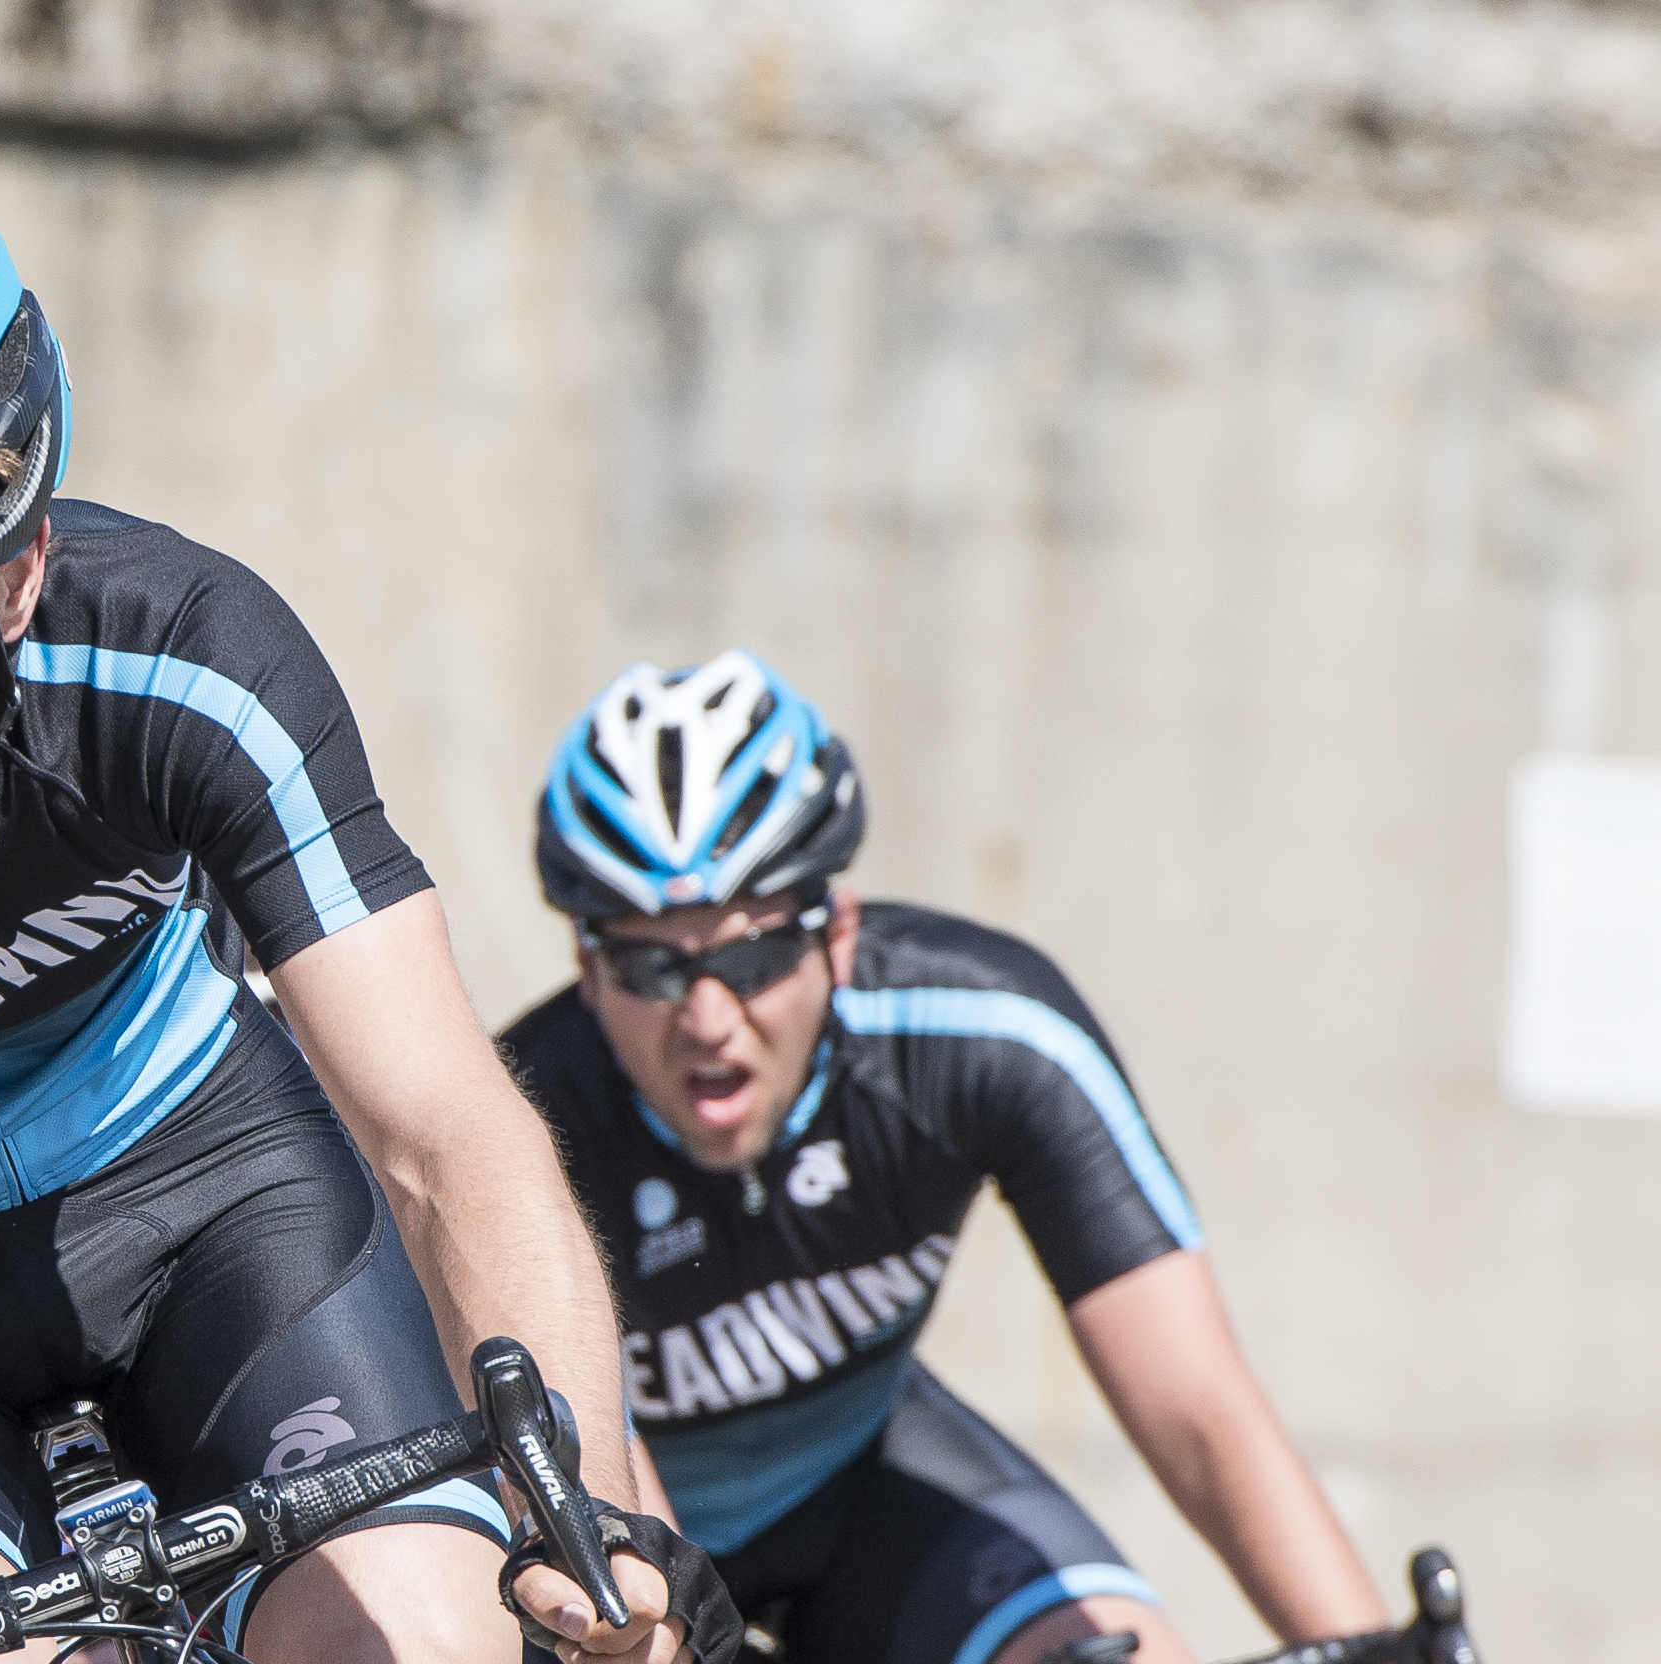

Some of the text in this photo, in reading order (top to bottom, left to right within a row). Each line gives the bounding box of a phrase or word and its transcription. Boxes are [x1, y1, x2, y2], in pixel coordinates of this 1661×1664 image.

[622, 1233, 955, 1422] EADWIN
[518, 1434, 566, 1511] RIVAL
[75, 1498, 134, 1528] GARMIN
[170, 1538, 205, 1560] RHM
[10, 1571, 81, 1613] Deda
